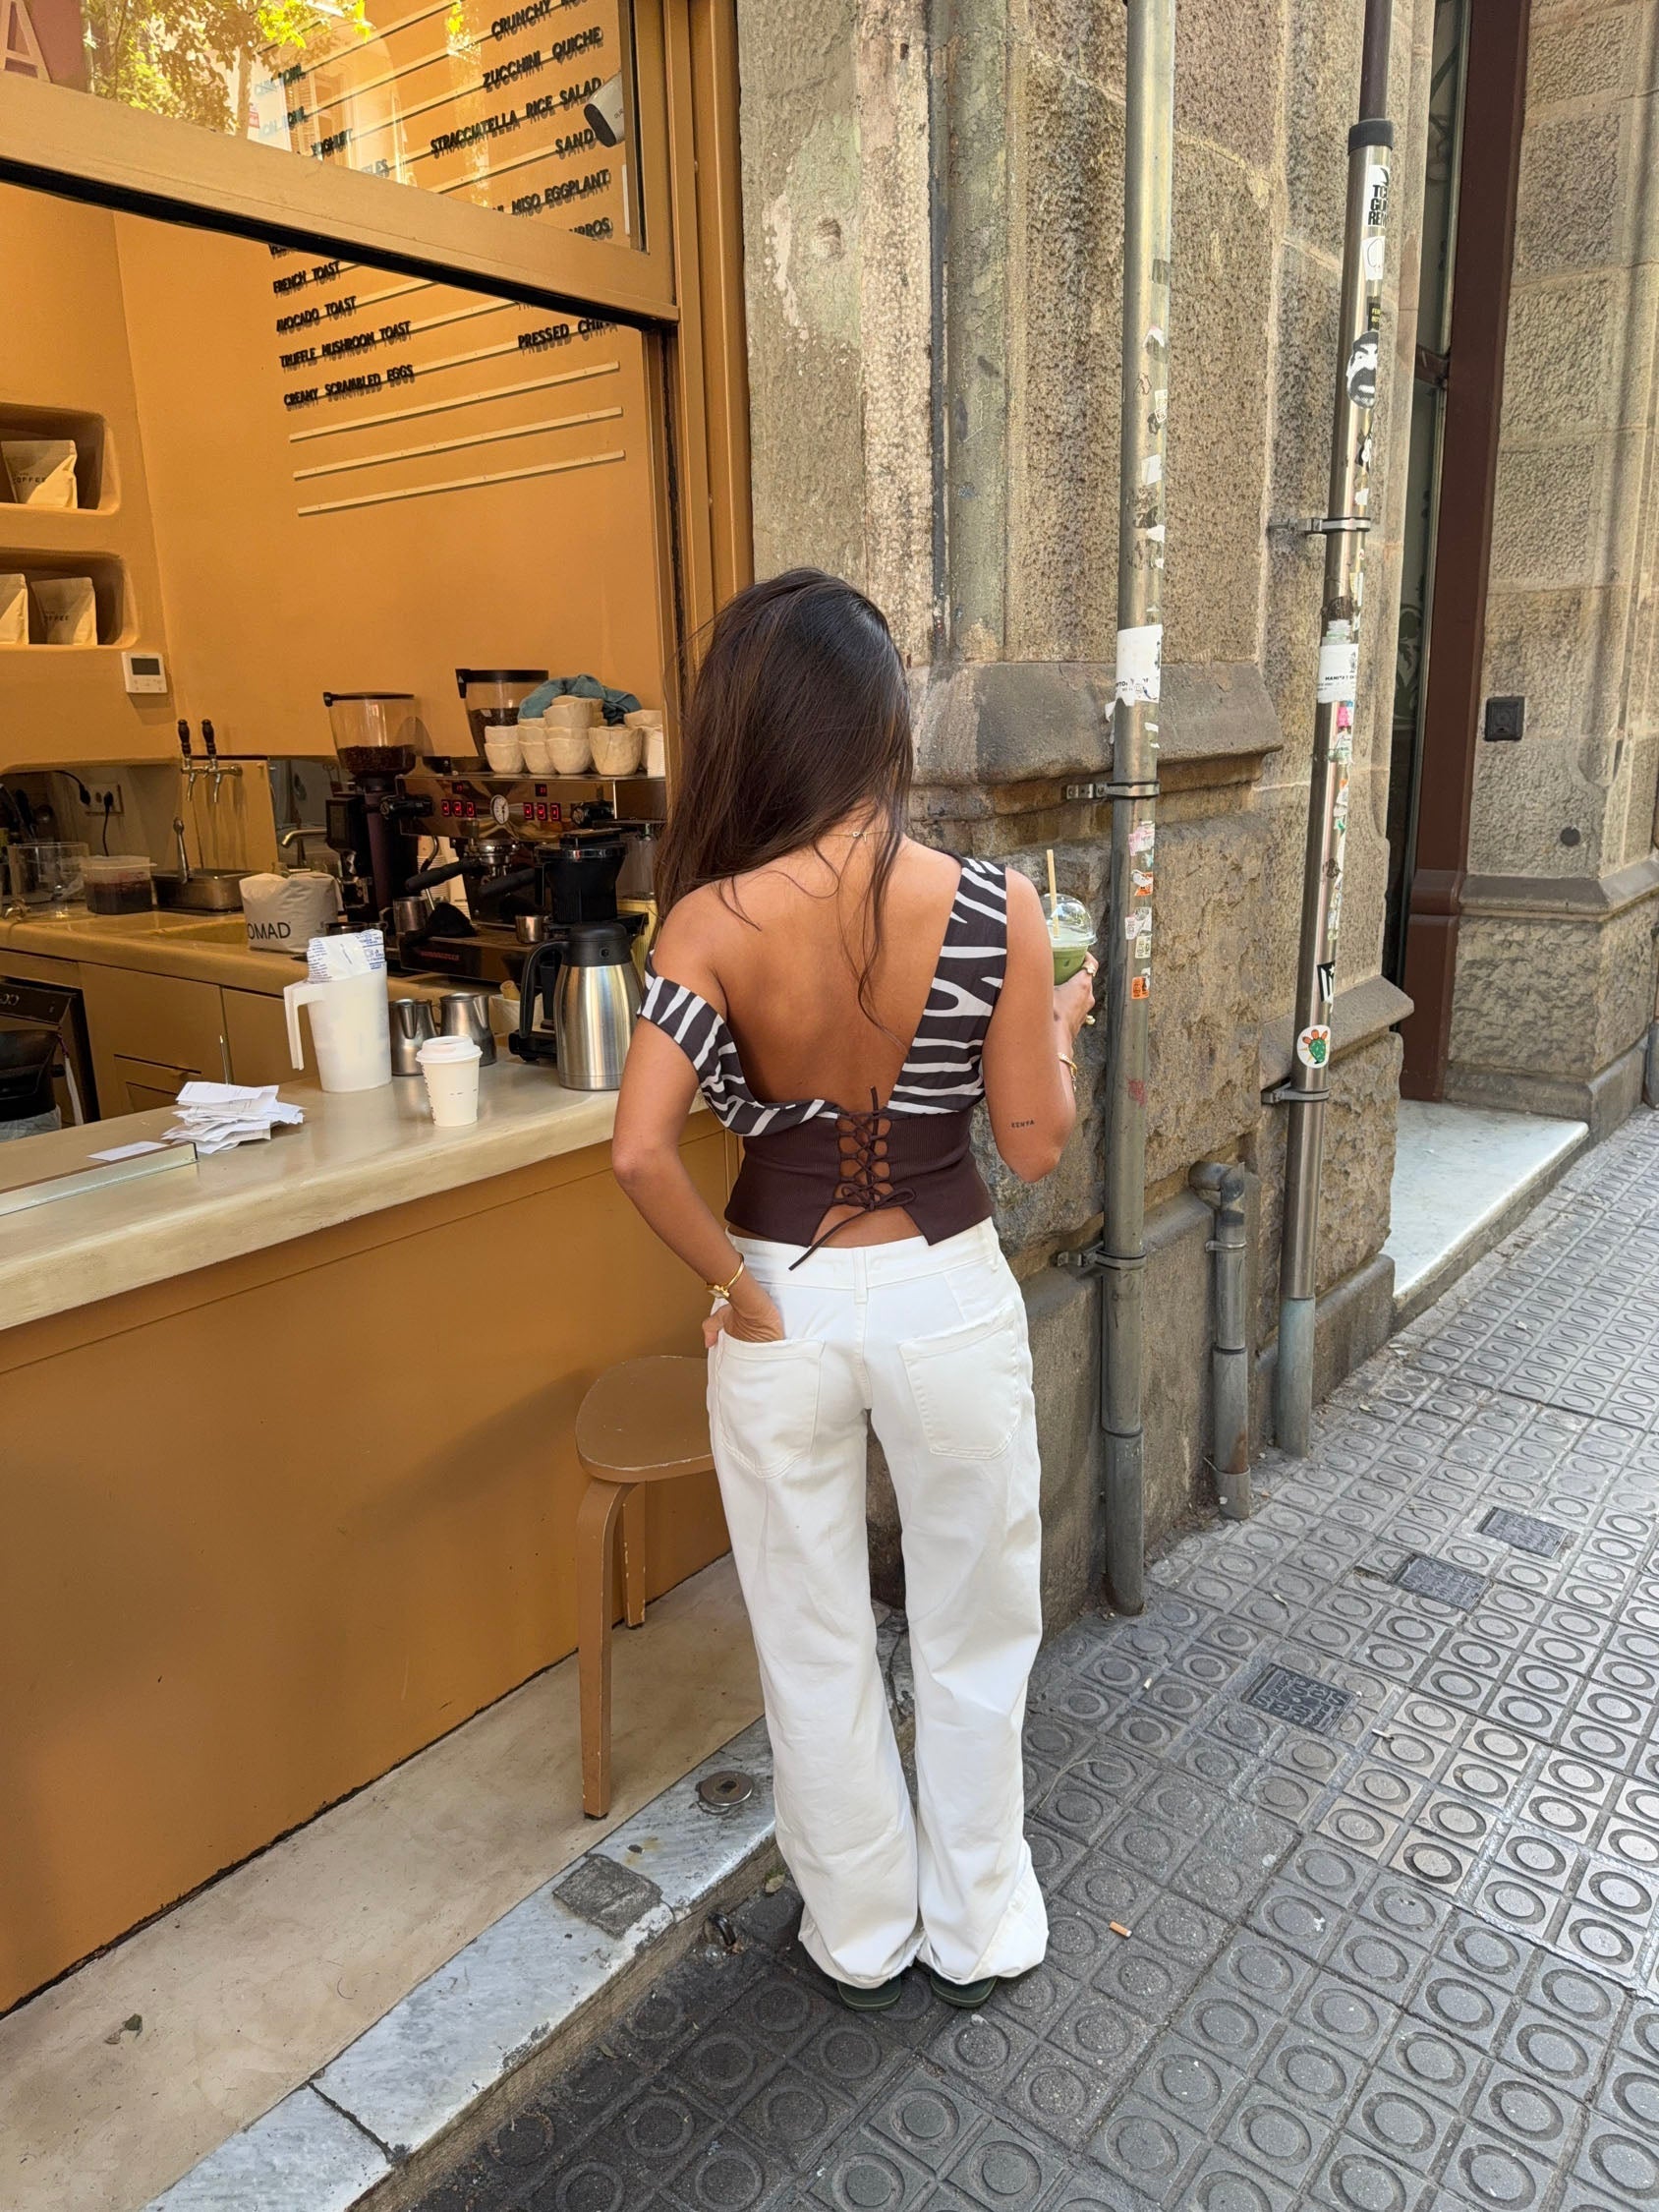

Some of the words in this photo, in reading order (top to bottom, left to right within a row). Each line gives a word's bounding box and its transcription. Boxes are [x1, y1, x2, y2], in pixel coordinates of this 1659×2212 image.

[483, 50, 542, 88] ZUCCHINI
[551, 27, 601, 59] QUICHE
[430, 110, 520, 155] STRACCIATELLA
[526, 95, 553, 120] RICE
[559, 77, 602, 105] SALAD
[511, 194, 542, 215] MISO
[544, 168, 609, 204] EGGPLANT
[273, 270, 307, 294] FRENCH
[312, 260, 341, 282] TOAST
[276, 308, 319, 332] AVOCADO
[324, 296, 357, 318] TOAST
[279, 347, 316, 369] TRUFFLE
[321, 331, 375, 357] MUSHROOM
[379, 320, 412, 340] TOAST
[518, 323, 570, 350] PRESSED
[284, 387, 318, 407] CREAMY
[324, 373, 381, 397] SCRAMBLED
[386, 364, 414, 382] EGGS
[247, 922, 291, 940] OMAD
